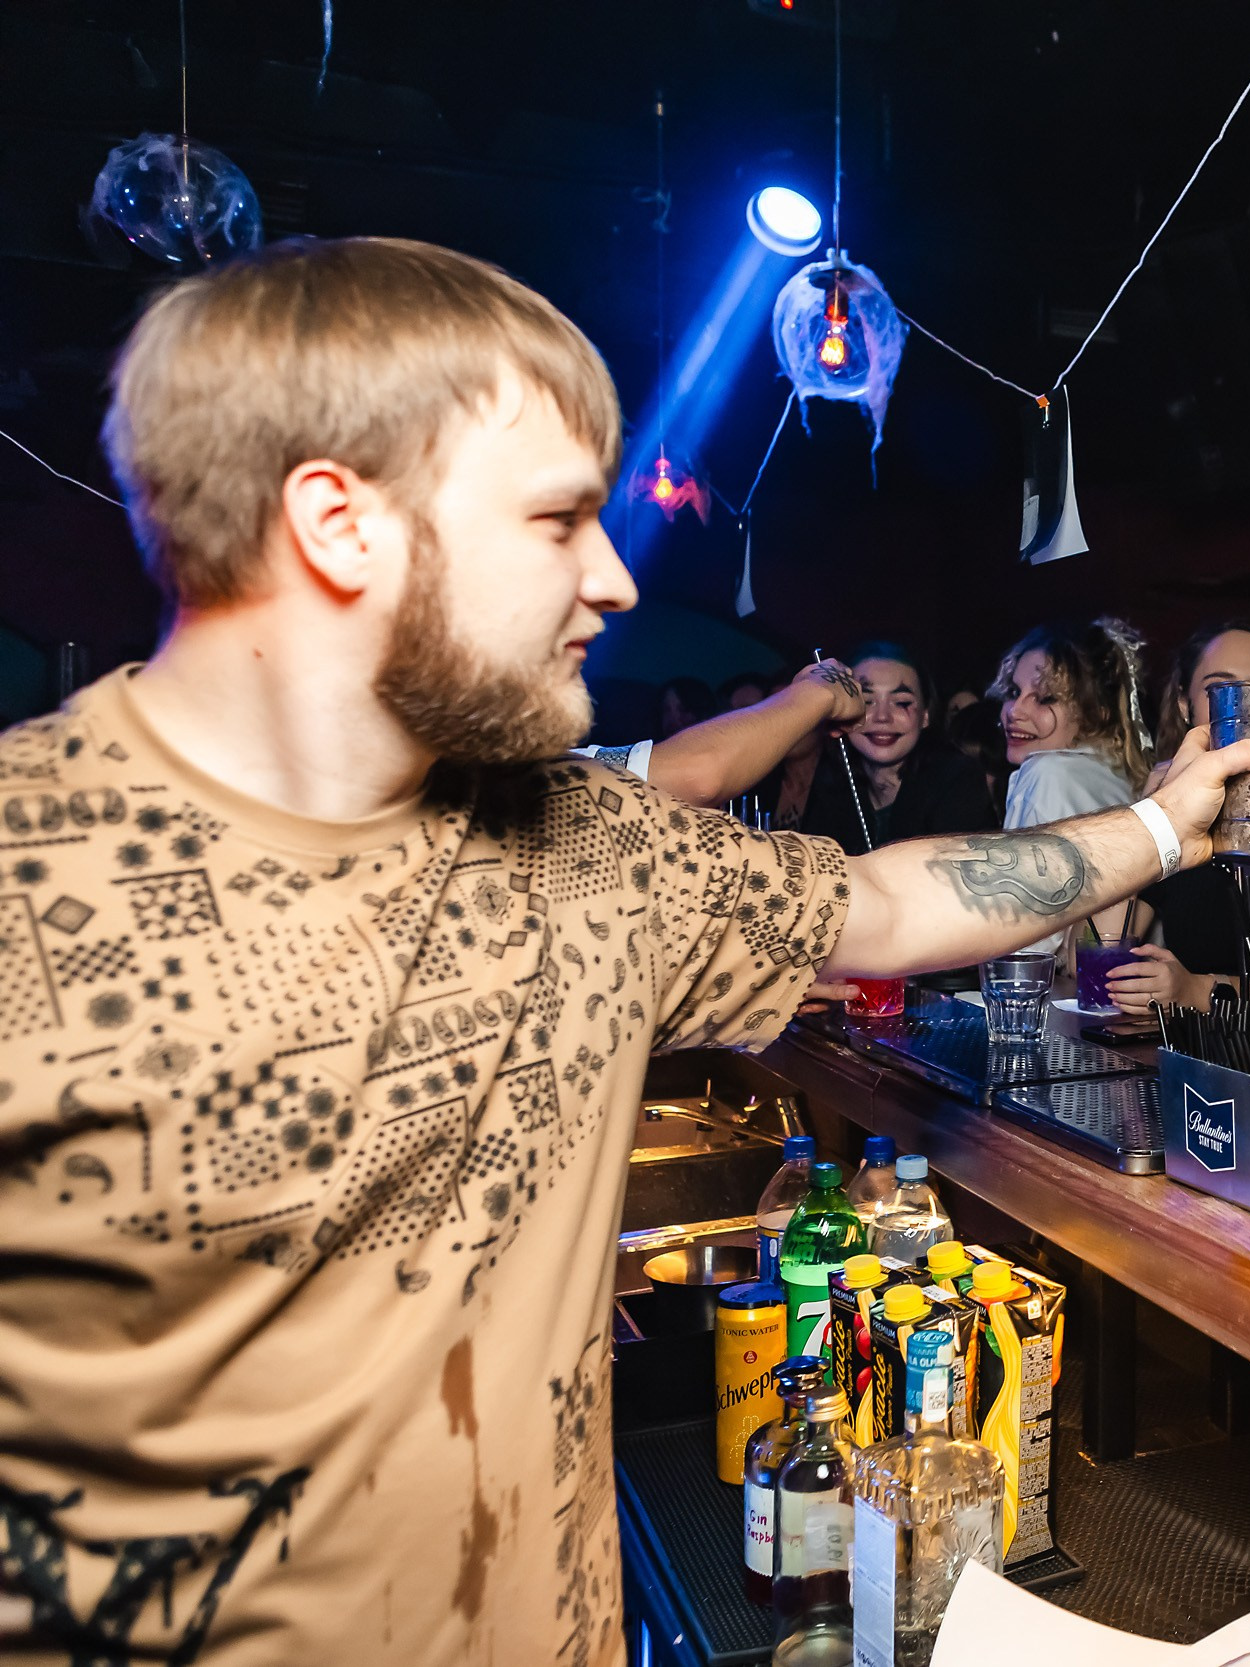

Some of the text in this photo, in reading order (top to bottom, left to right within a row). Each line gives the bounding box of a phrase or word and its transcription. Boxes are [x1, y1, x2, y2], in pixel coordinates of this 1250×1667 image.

[1188, 1110, 1232, 1144] Ballantine's
[1198, 1134, 1223, 1154] STAY TRUE
[832, 1287, 856, 1305] PREMIUM
[721, 1324, 780, 1338] TONIC WATER
[872, 1319, 896, 1339] PREMIUM
[749, 1509, 767, 1526] Gin
